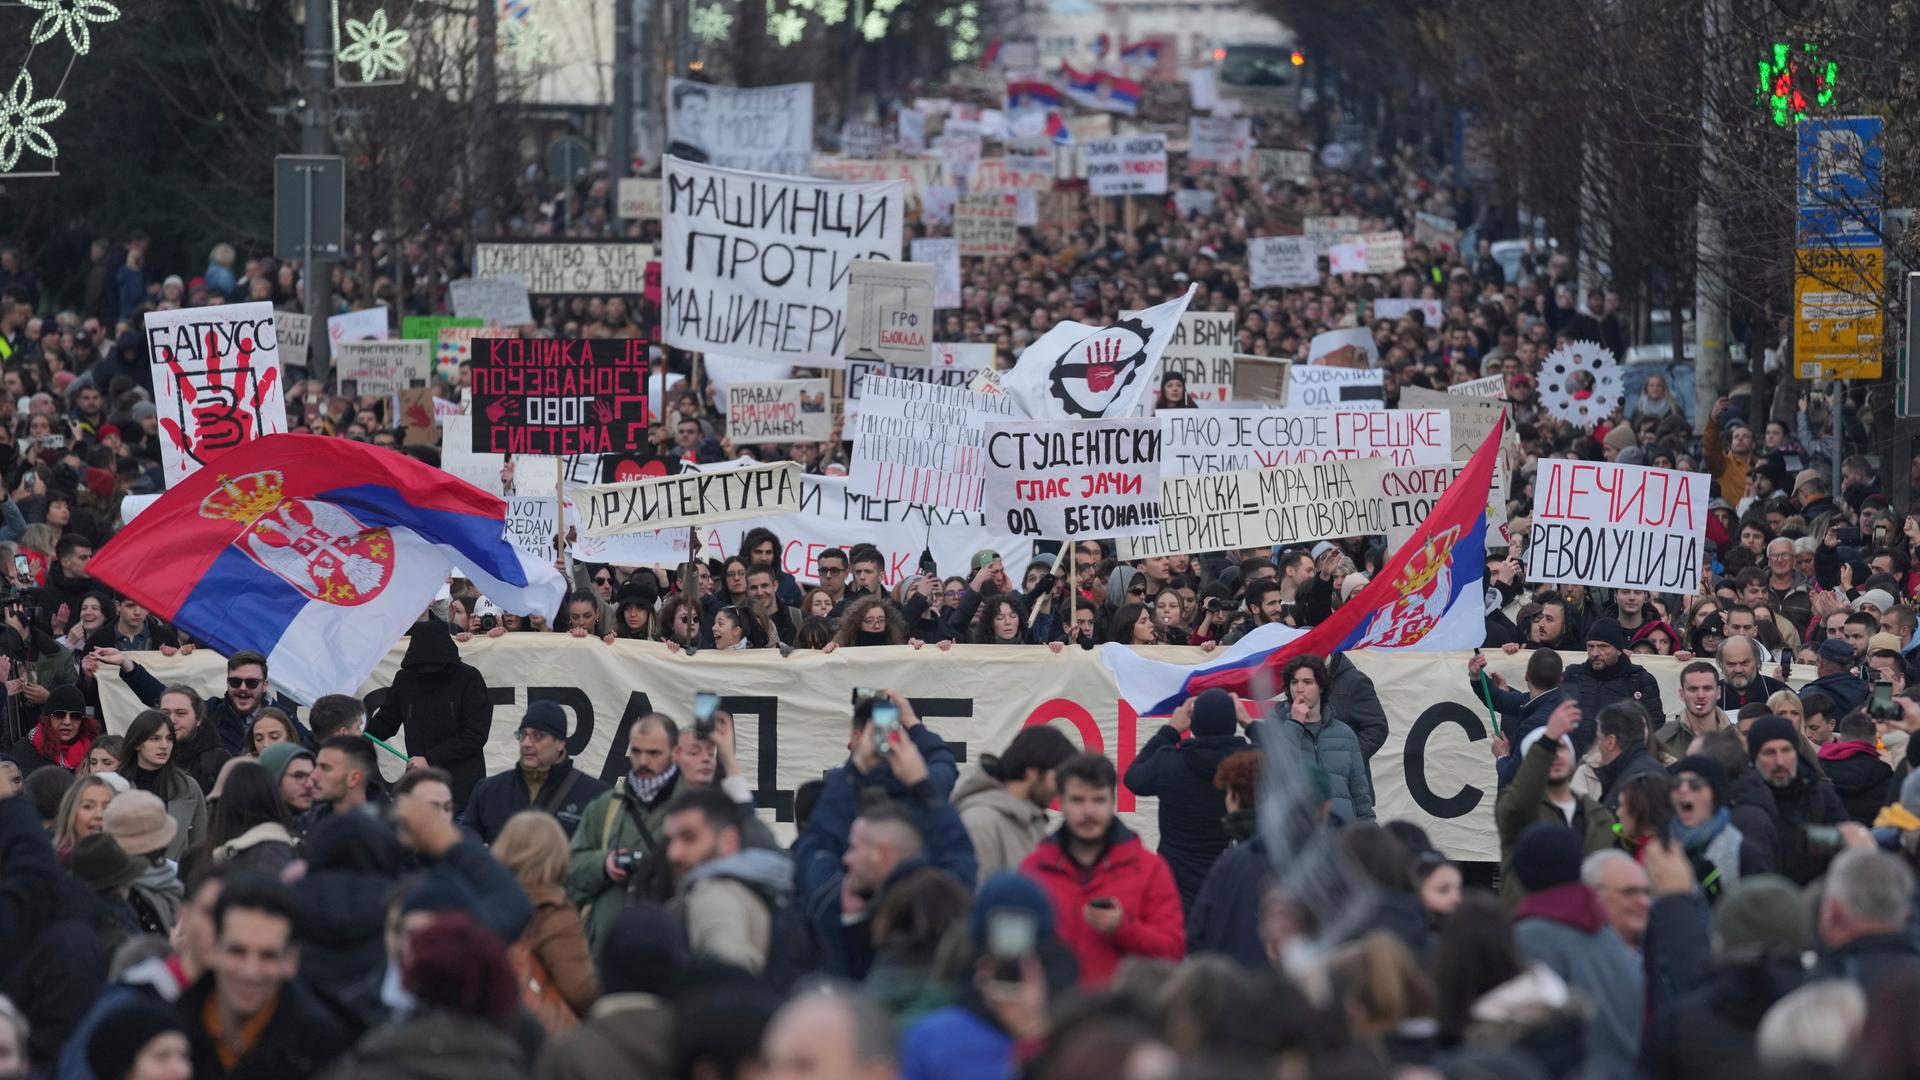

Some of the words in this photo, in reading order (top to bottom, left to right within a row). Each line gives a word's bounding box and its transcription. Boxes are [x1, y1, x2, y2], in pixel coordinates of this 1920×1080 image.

[668, 173, 888, 240] МАШИНЦИ
[686, 231, 891, 292] ПРОТИ
[1866, 253, 1875, 267] 2
[666, 286, 847, 356] МАШИНЕРИ
[892, 311, 918, 327] ГРФ
[1194, 319, 1233, 346] ВАМ
[881, 330, 925, 346] БЛОКАДА
[489, 339, 595, 367] КОЛИКА
[614, 339, 648, 366] ЈЕ
[472, 367, 648, 396] ПОУЗДАНОСТ
[1212, 358, 1232, 385] НА
[731, 387, 783, 404] ПРАВДУ
[1303, 386, 1331, 406] ОД
[526, 396, 595, 425] ОВОГ
[731, 402, 796, 421] БРАНИМО
[490, 426, 612, 454] СИСТЕМА
[730, 419, 804, 437] ЋУТАЊЕМ
[1165, 417, 1221, 447] ЛАКО
[1228, 417, 1251, 447] ЈЕ
[1257, 416, 1328, 447] СВОЈЕ
[1335, 412, 1442, 448] ГРЕШКЕ
[988, 428, 1162, 471] СТУДЕНТСКИ
[587, 467, 797, 530] АРХИТЕКТУРА
[1016, 477, 1071, 501] ГЛАС
[1080, 471, 1143, 499] ЈАЧИ
[1161, 473, 1241, 517] ДЕМСКИ
[1260, 463, 1355, 506] МОРАЛНА
[1540, 464, 1694, 530] ДЕЧИЈА
[507, 501, 547, 518] IVOT
[1006, 507, 1043, 537] ОД
[1064, 501, 1160, 535] БЕТОНА!!!
[1265, 497, 1387, 542] ОДГОВОРНОС
[504, 519, 553, 535] REDAN
[1528, 523, 1698, 591] РЕВОЛУЦИЈА
